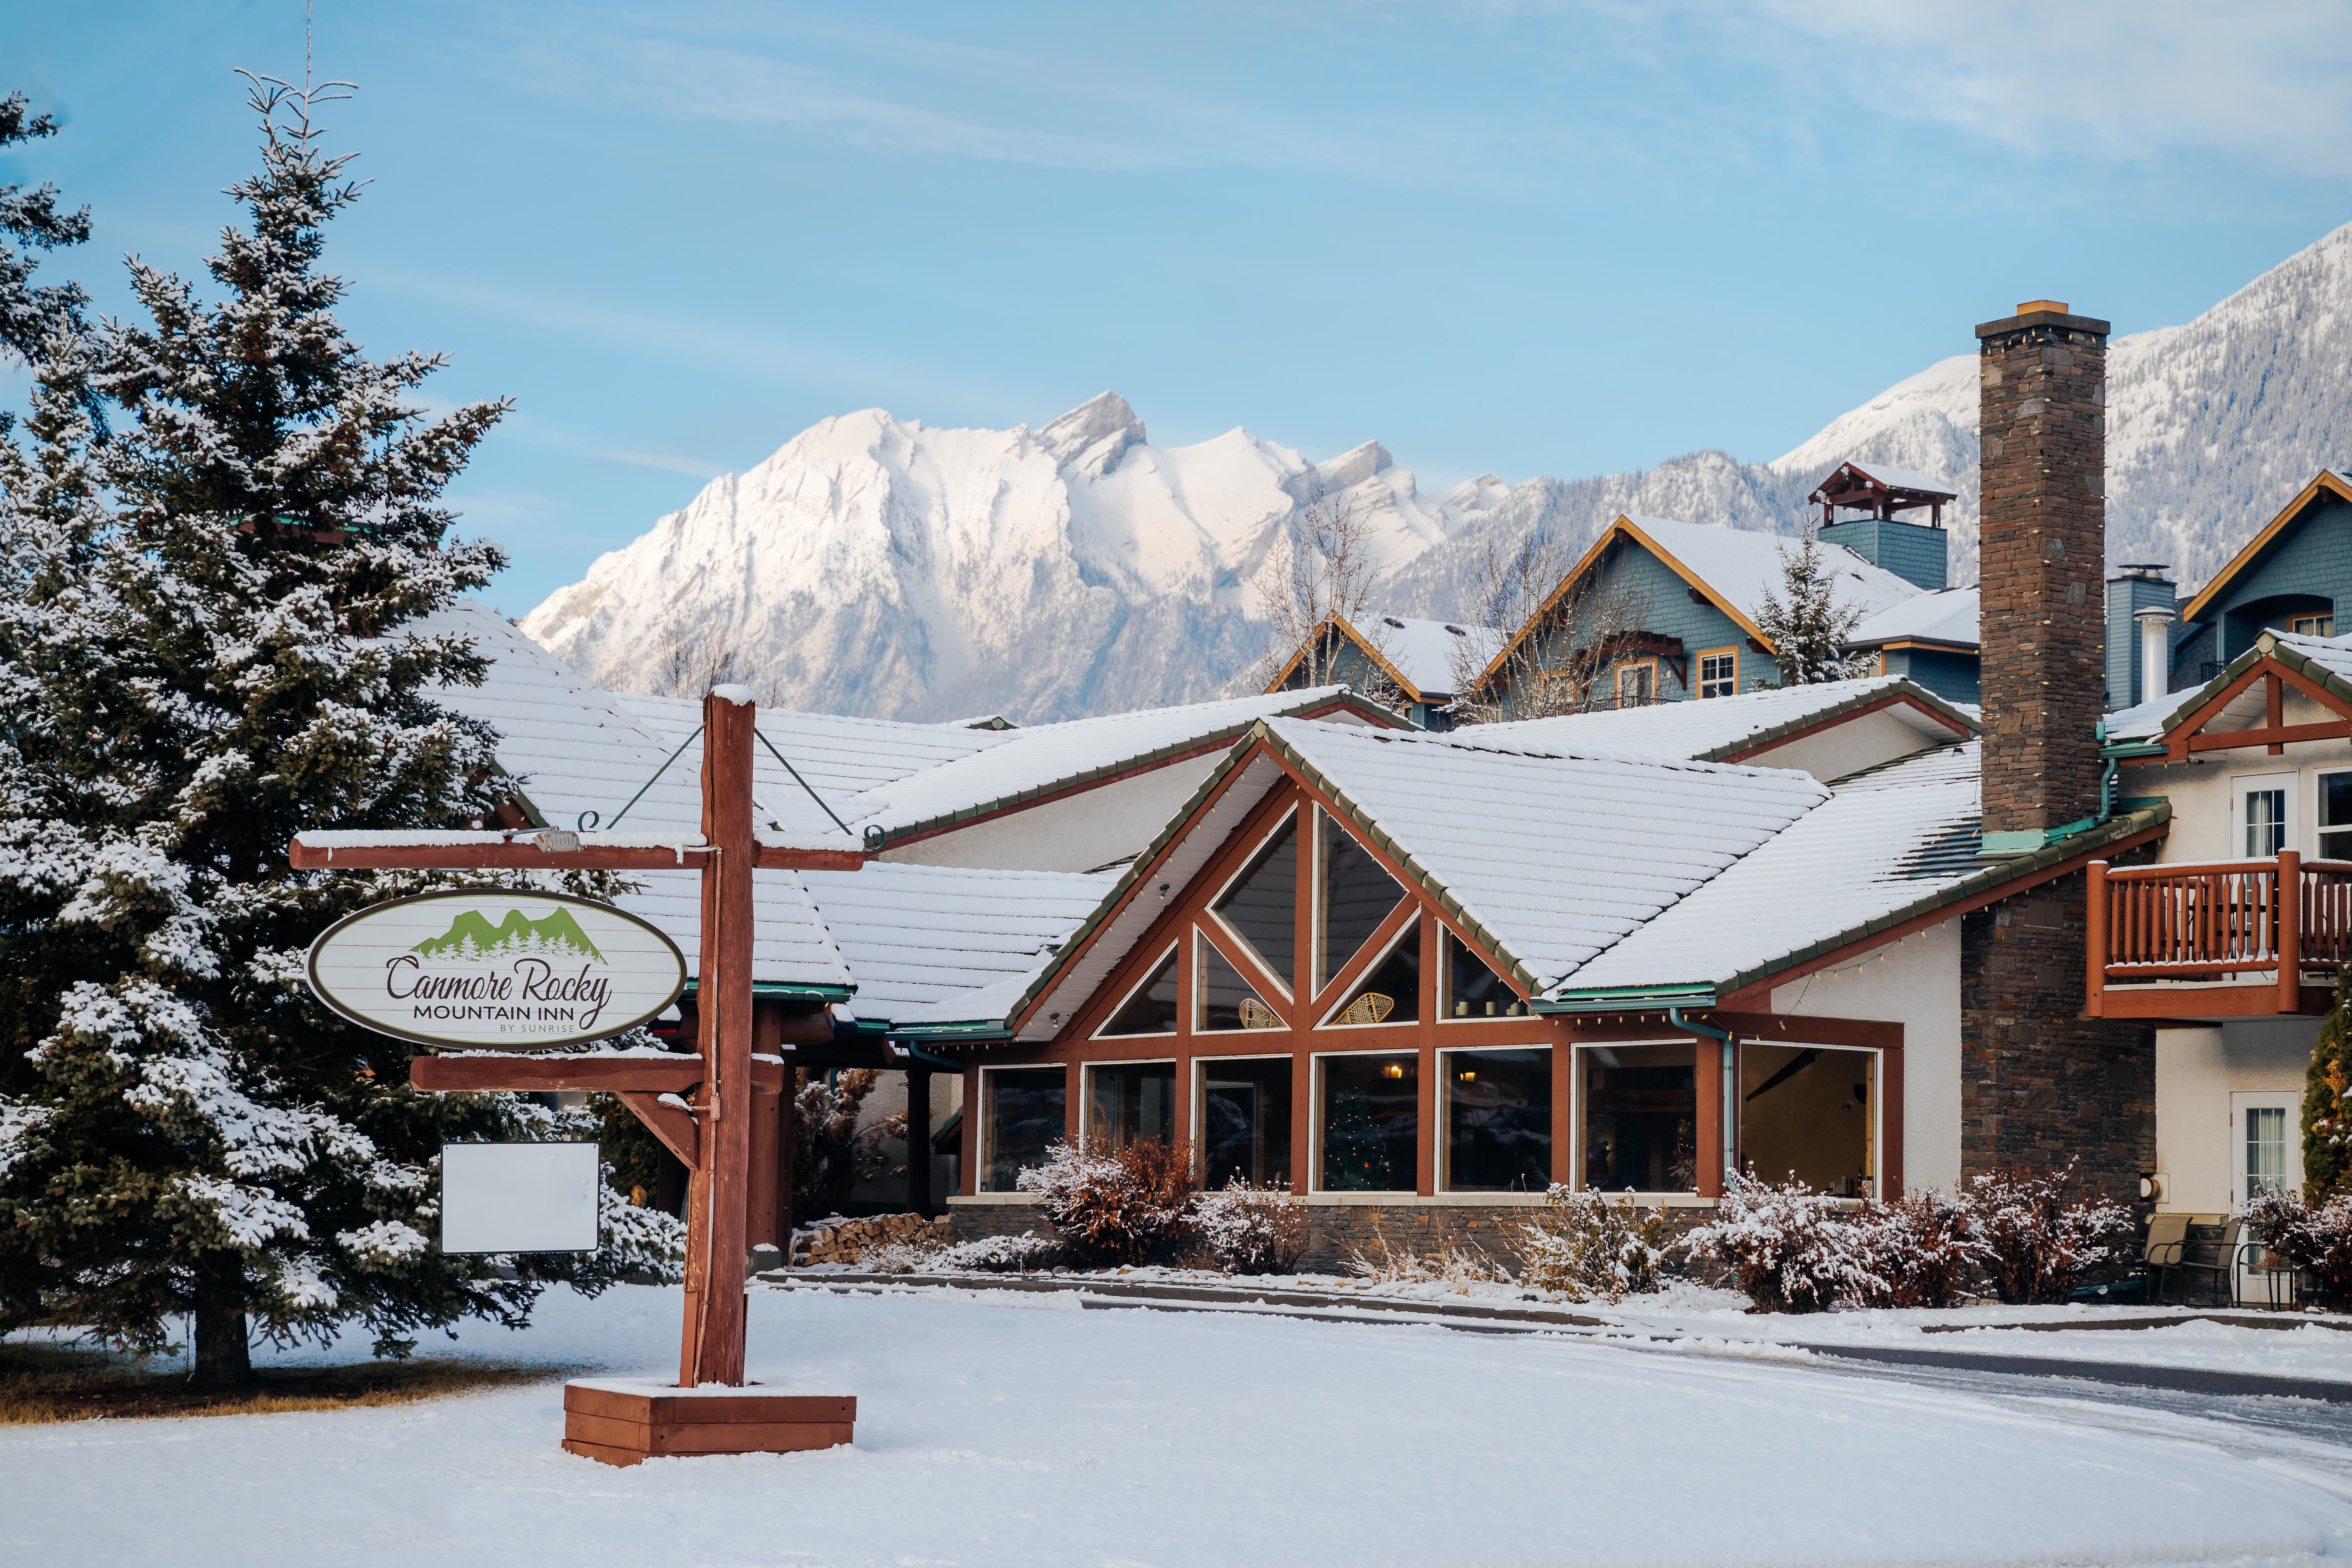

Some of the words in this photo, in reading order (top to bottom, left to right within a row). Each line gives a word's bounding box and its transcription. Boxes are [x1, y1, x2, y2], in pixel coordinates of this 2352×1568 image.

[386, 955, 512, 1000] Canmore
[514, 958, 612, 1030] Rocky
[414, 1005, 530, 1020] MOUNTAIN
[539, 1007, 574, 1021] INN
